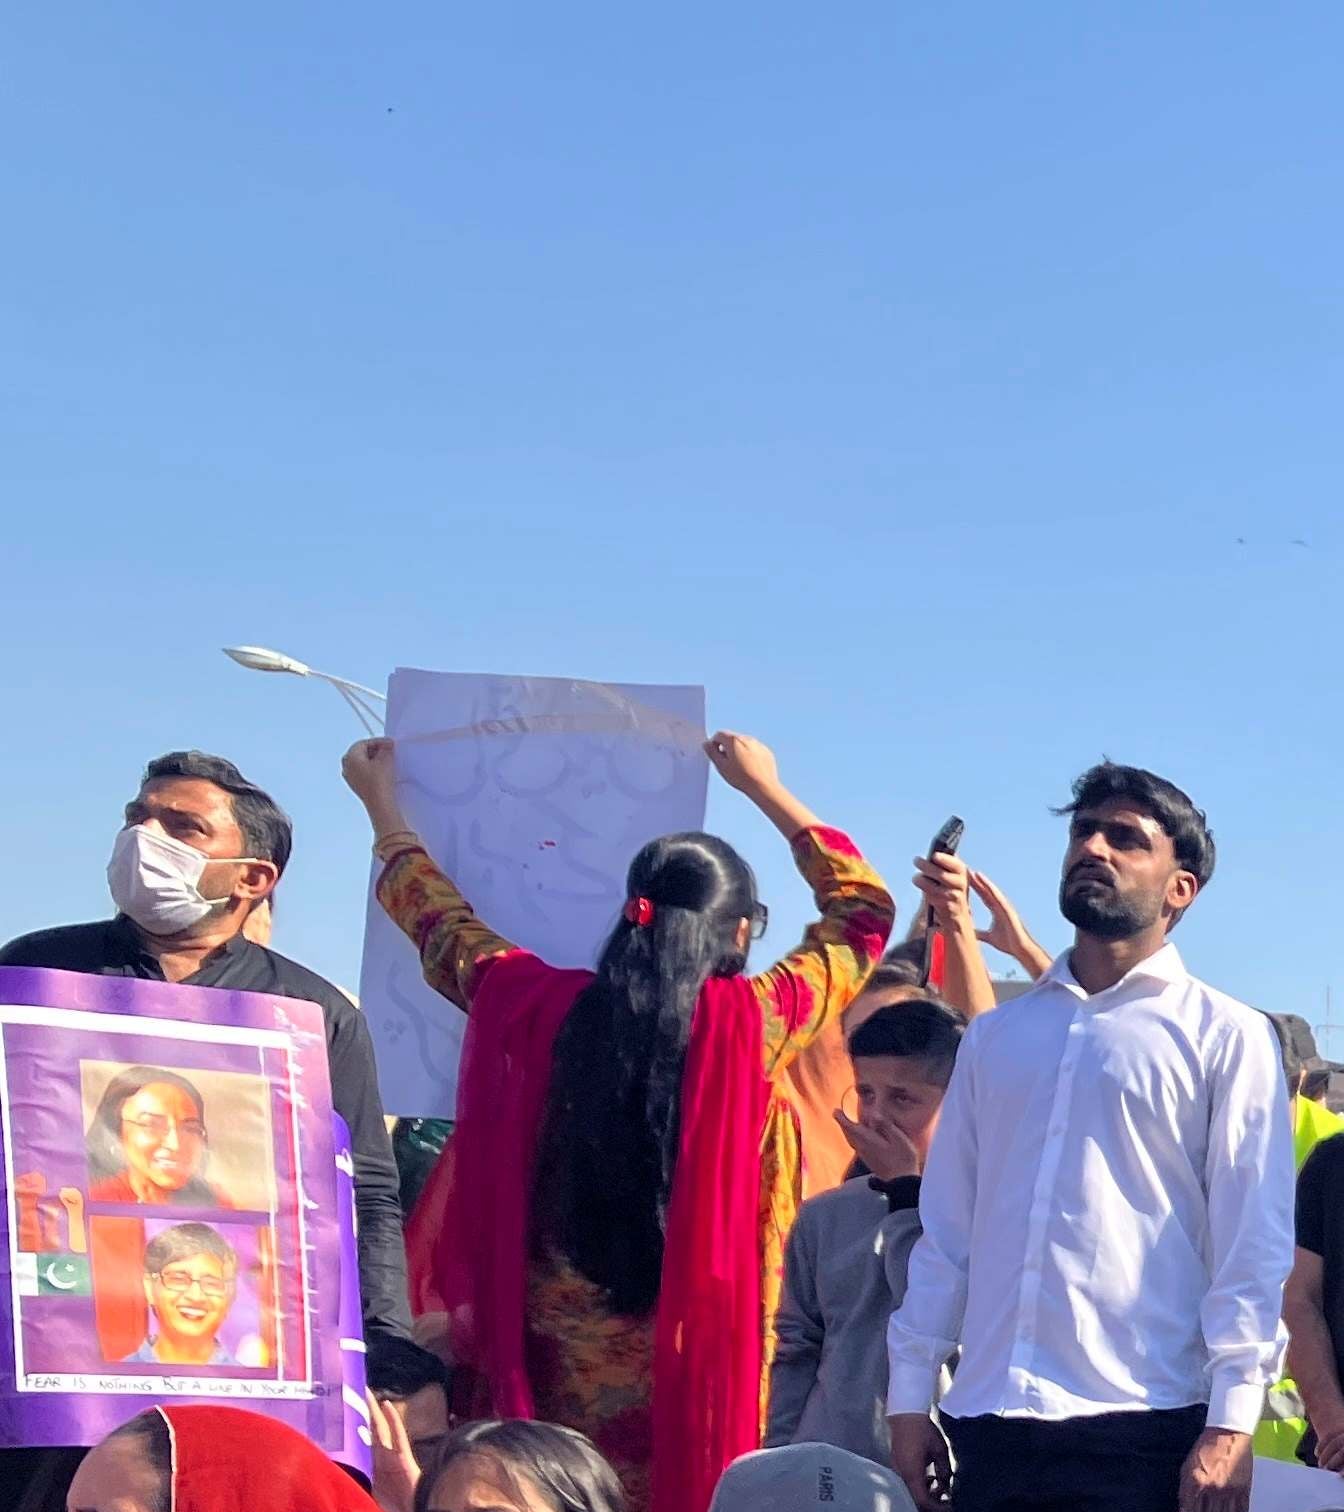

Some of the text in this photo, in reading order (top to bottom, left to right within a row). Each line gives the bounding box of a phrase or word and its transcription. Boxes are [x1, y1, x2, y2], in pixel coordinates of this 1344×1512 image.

[25, 1374, 61, 1389] FEAR
[73, 1377, 86, 1389] IS
[99, 1377, 152, 1391] NOTHING
[818, 1466, 835, 1502] PARIS
